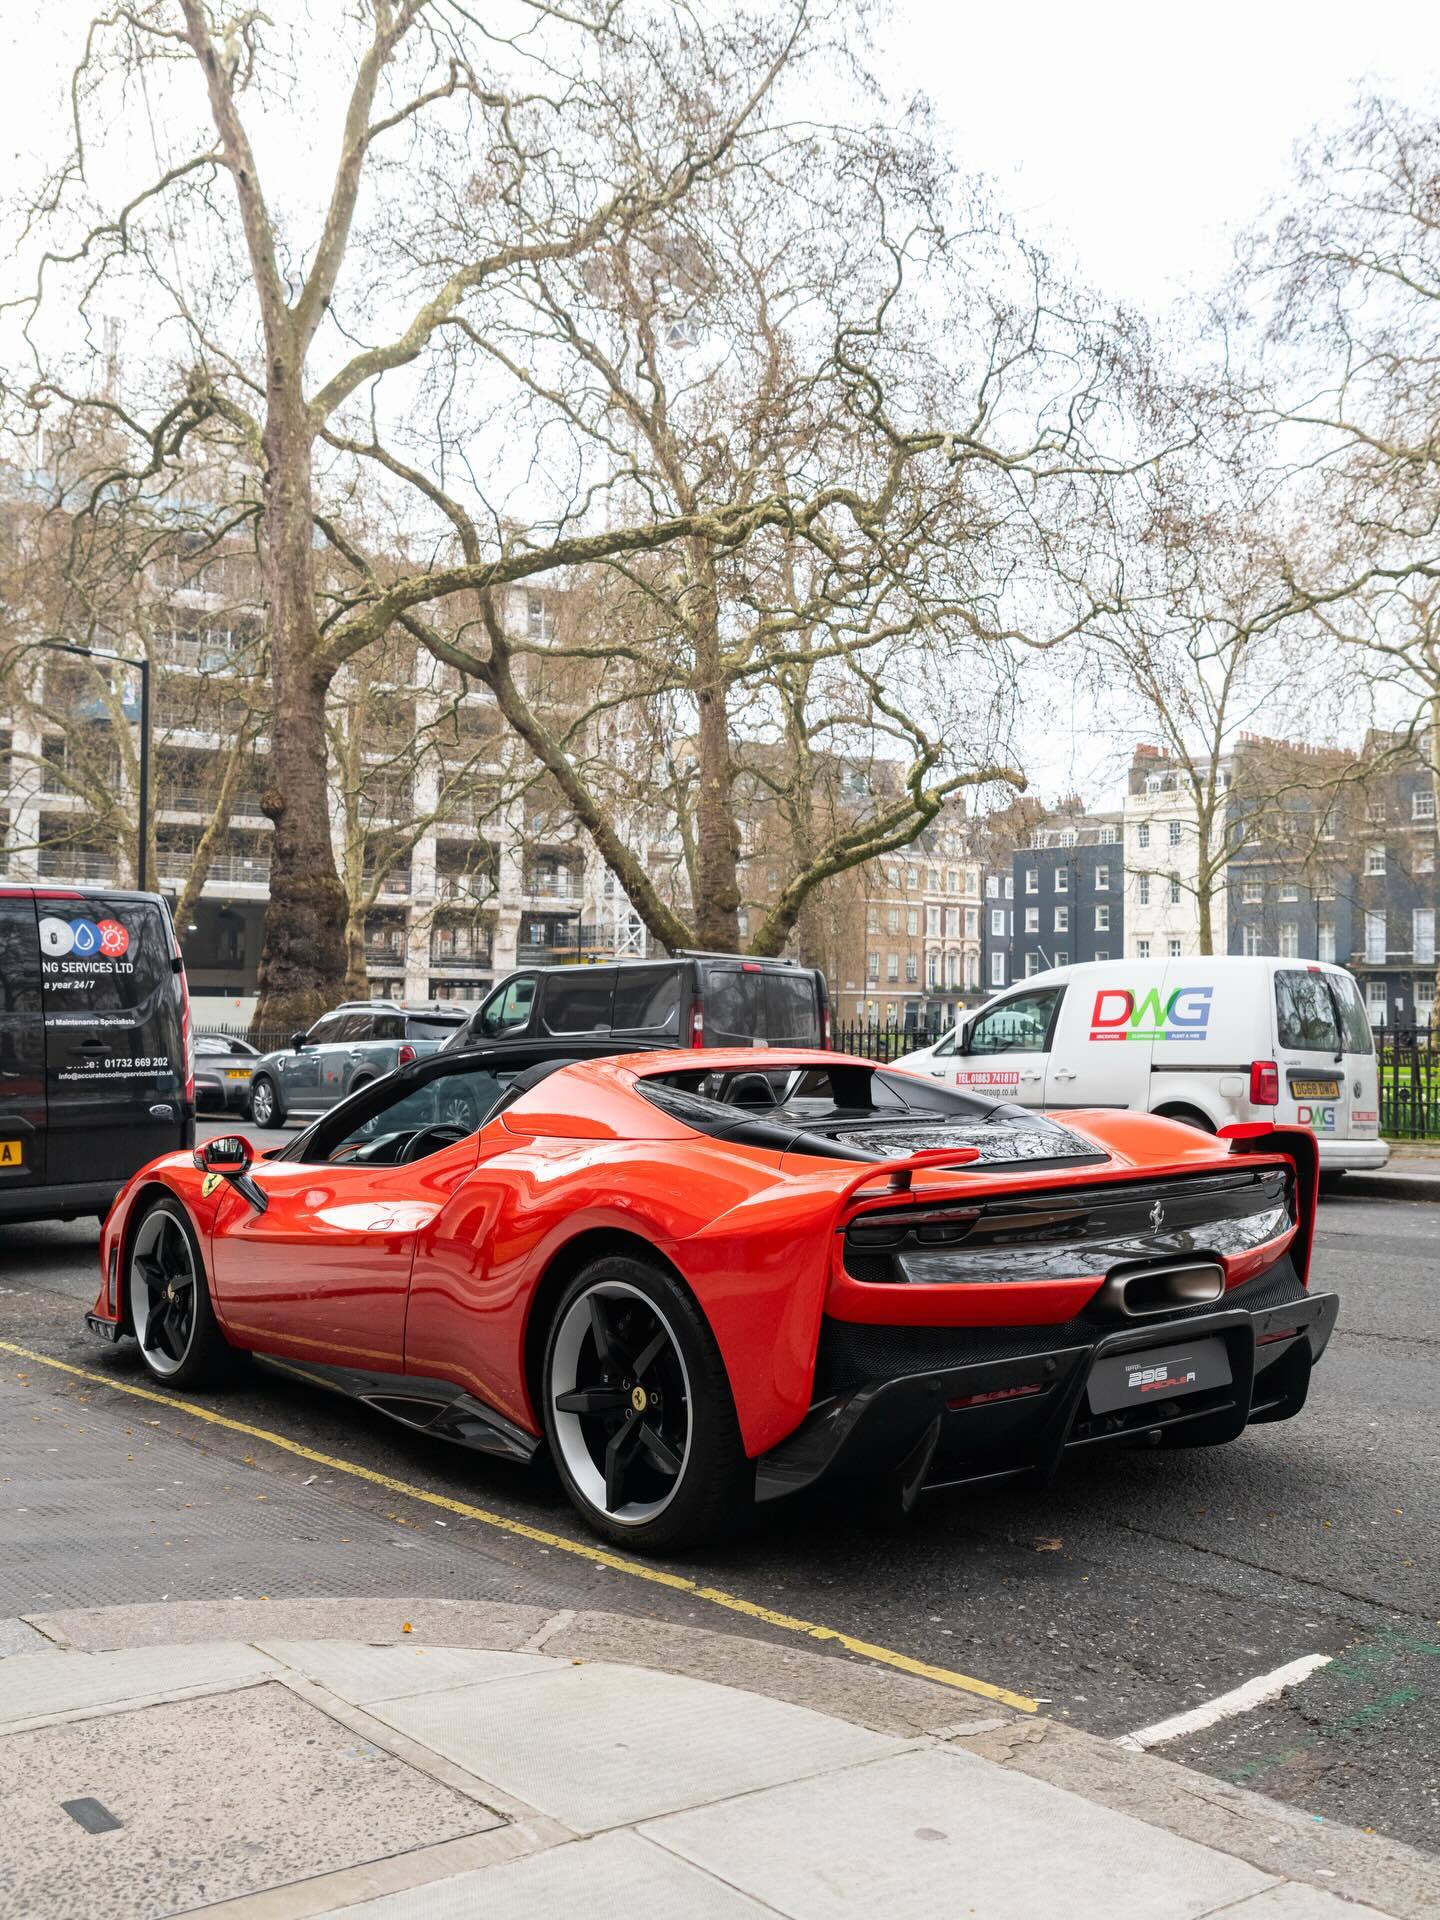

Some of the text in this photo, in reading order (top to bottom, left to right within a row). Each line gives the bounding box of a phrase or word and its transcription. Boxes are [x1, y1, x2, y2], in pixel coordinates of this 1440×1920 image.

[42, 962, 134, 974] NG SERVICES LTD
[44, 980, 96, 991] a year 24/7
[1091, 986, 1214, 1028] DWG
[55, 1018, 99, 1026] Maintenance
[100, 1018, 136, 1027] Specialists
[104, 1058, 133, 1068] 01732
[134, 1057, 151, 1067] 669
[152, 1057, 168, 1067] 202
[1297, 1105, 1335, 1125] DWG
[2, 1144, 12, 1161] A
[1128, 1366, 1167, 1387] 296
